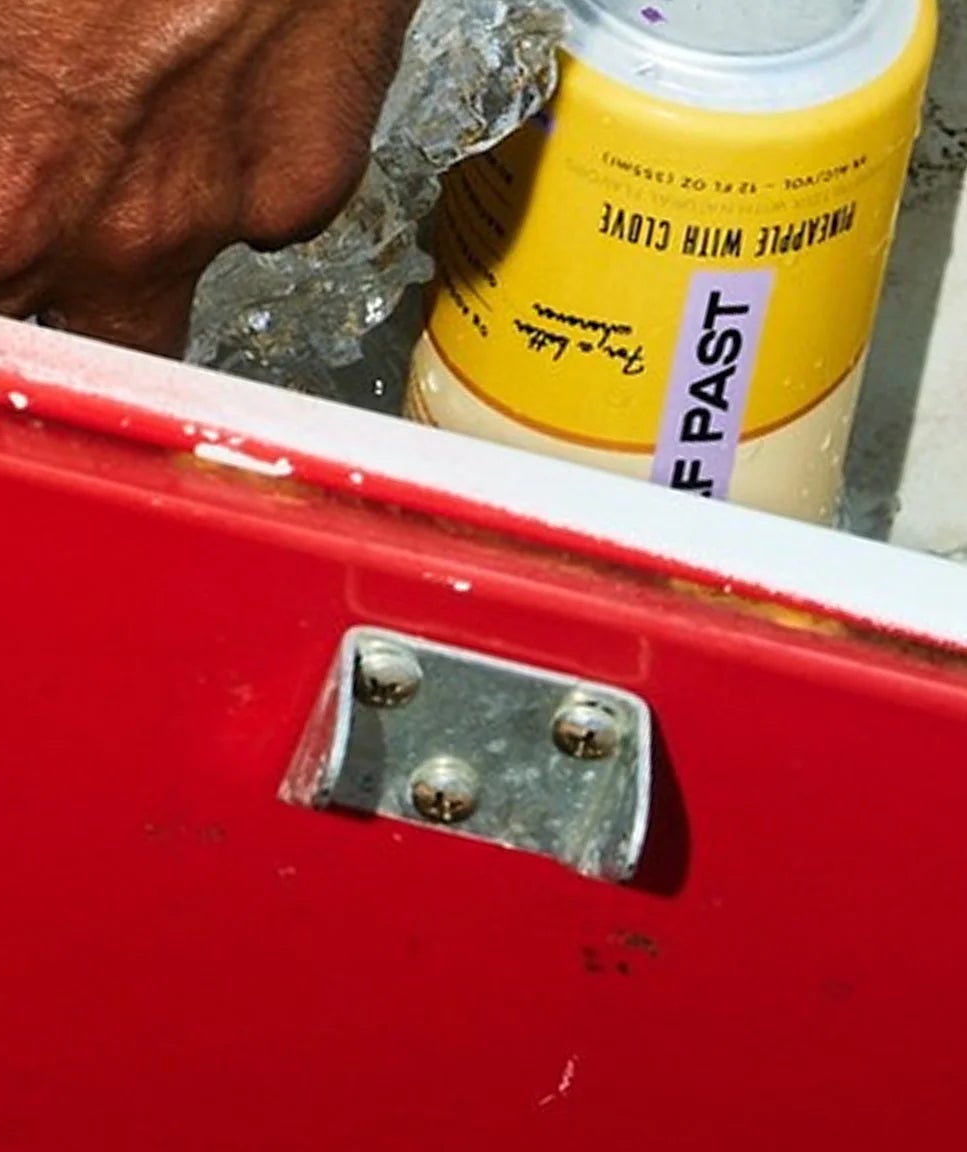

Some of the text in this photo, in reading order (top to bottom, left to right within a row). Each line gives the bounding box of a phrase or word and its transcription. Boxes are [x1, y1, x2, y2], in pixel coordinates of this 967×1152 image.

[680, 177, 707, 193] OZ
[598, 200, 857, 258] PINEAPPLE WITH CLOVE
[514, 318, 645, 376] For a better
[532, 302, 632, 348] whenever
[680, 290, 750, 444] PAST
